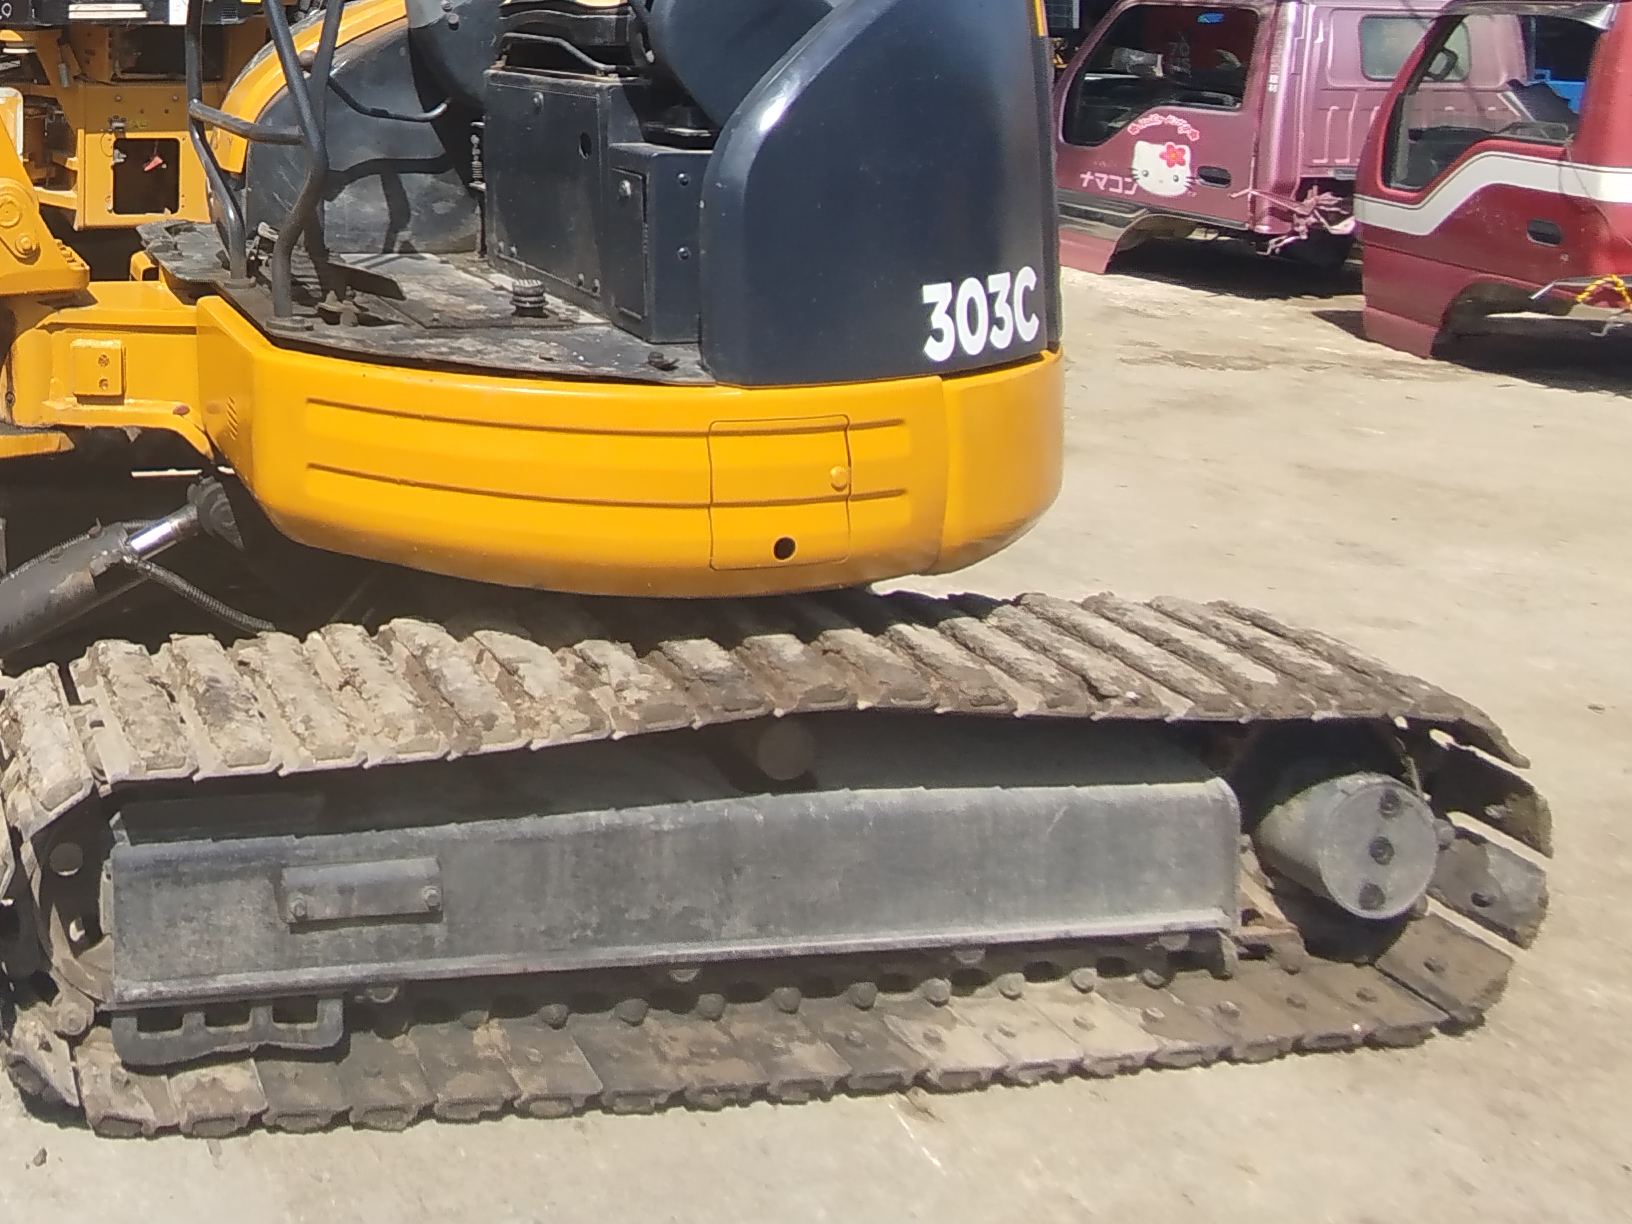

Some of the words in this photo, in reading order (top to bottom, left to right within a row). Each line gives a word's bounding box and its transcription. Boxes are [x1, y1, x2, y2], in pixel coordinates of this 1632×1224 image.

[1079, 171, 1138, 195] ナマコン
[922, 265, 1040, 362] 303C
